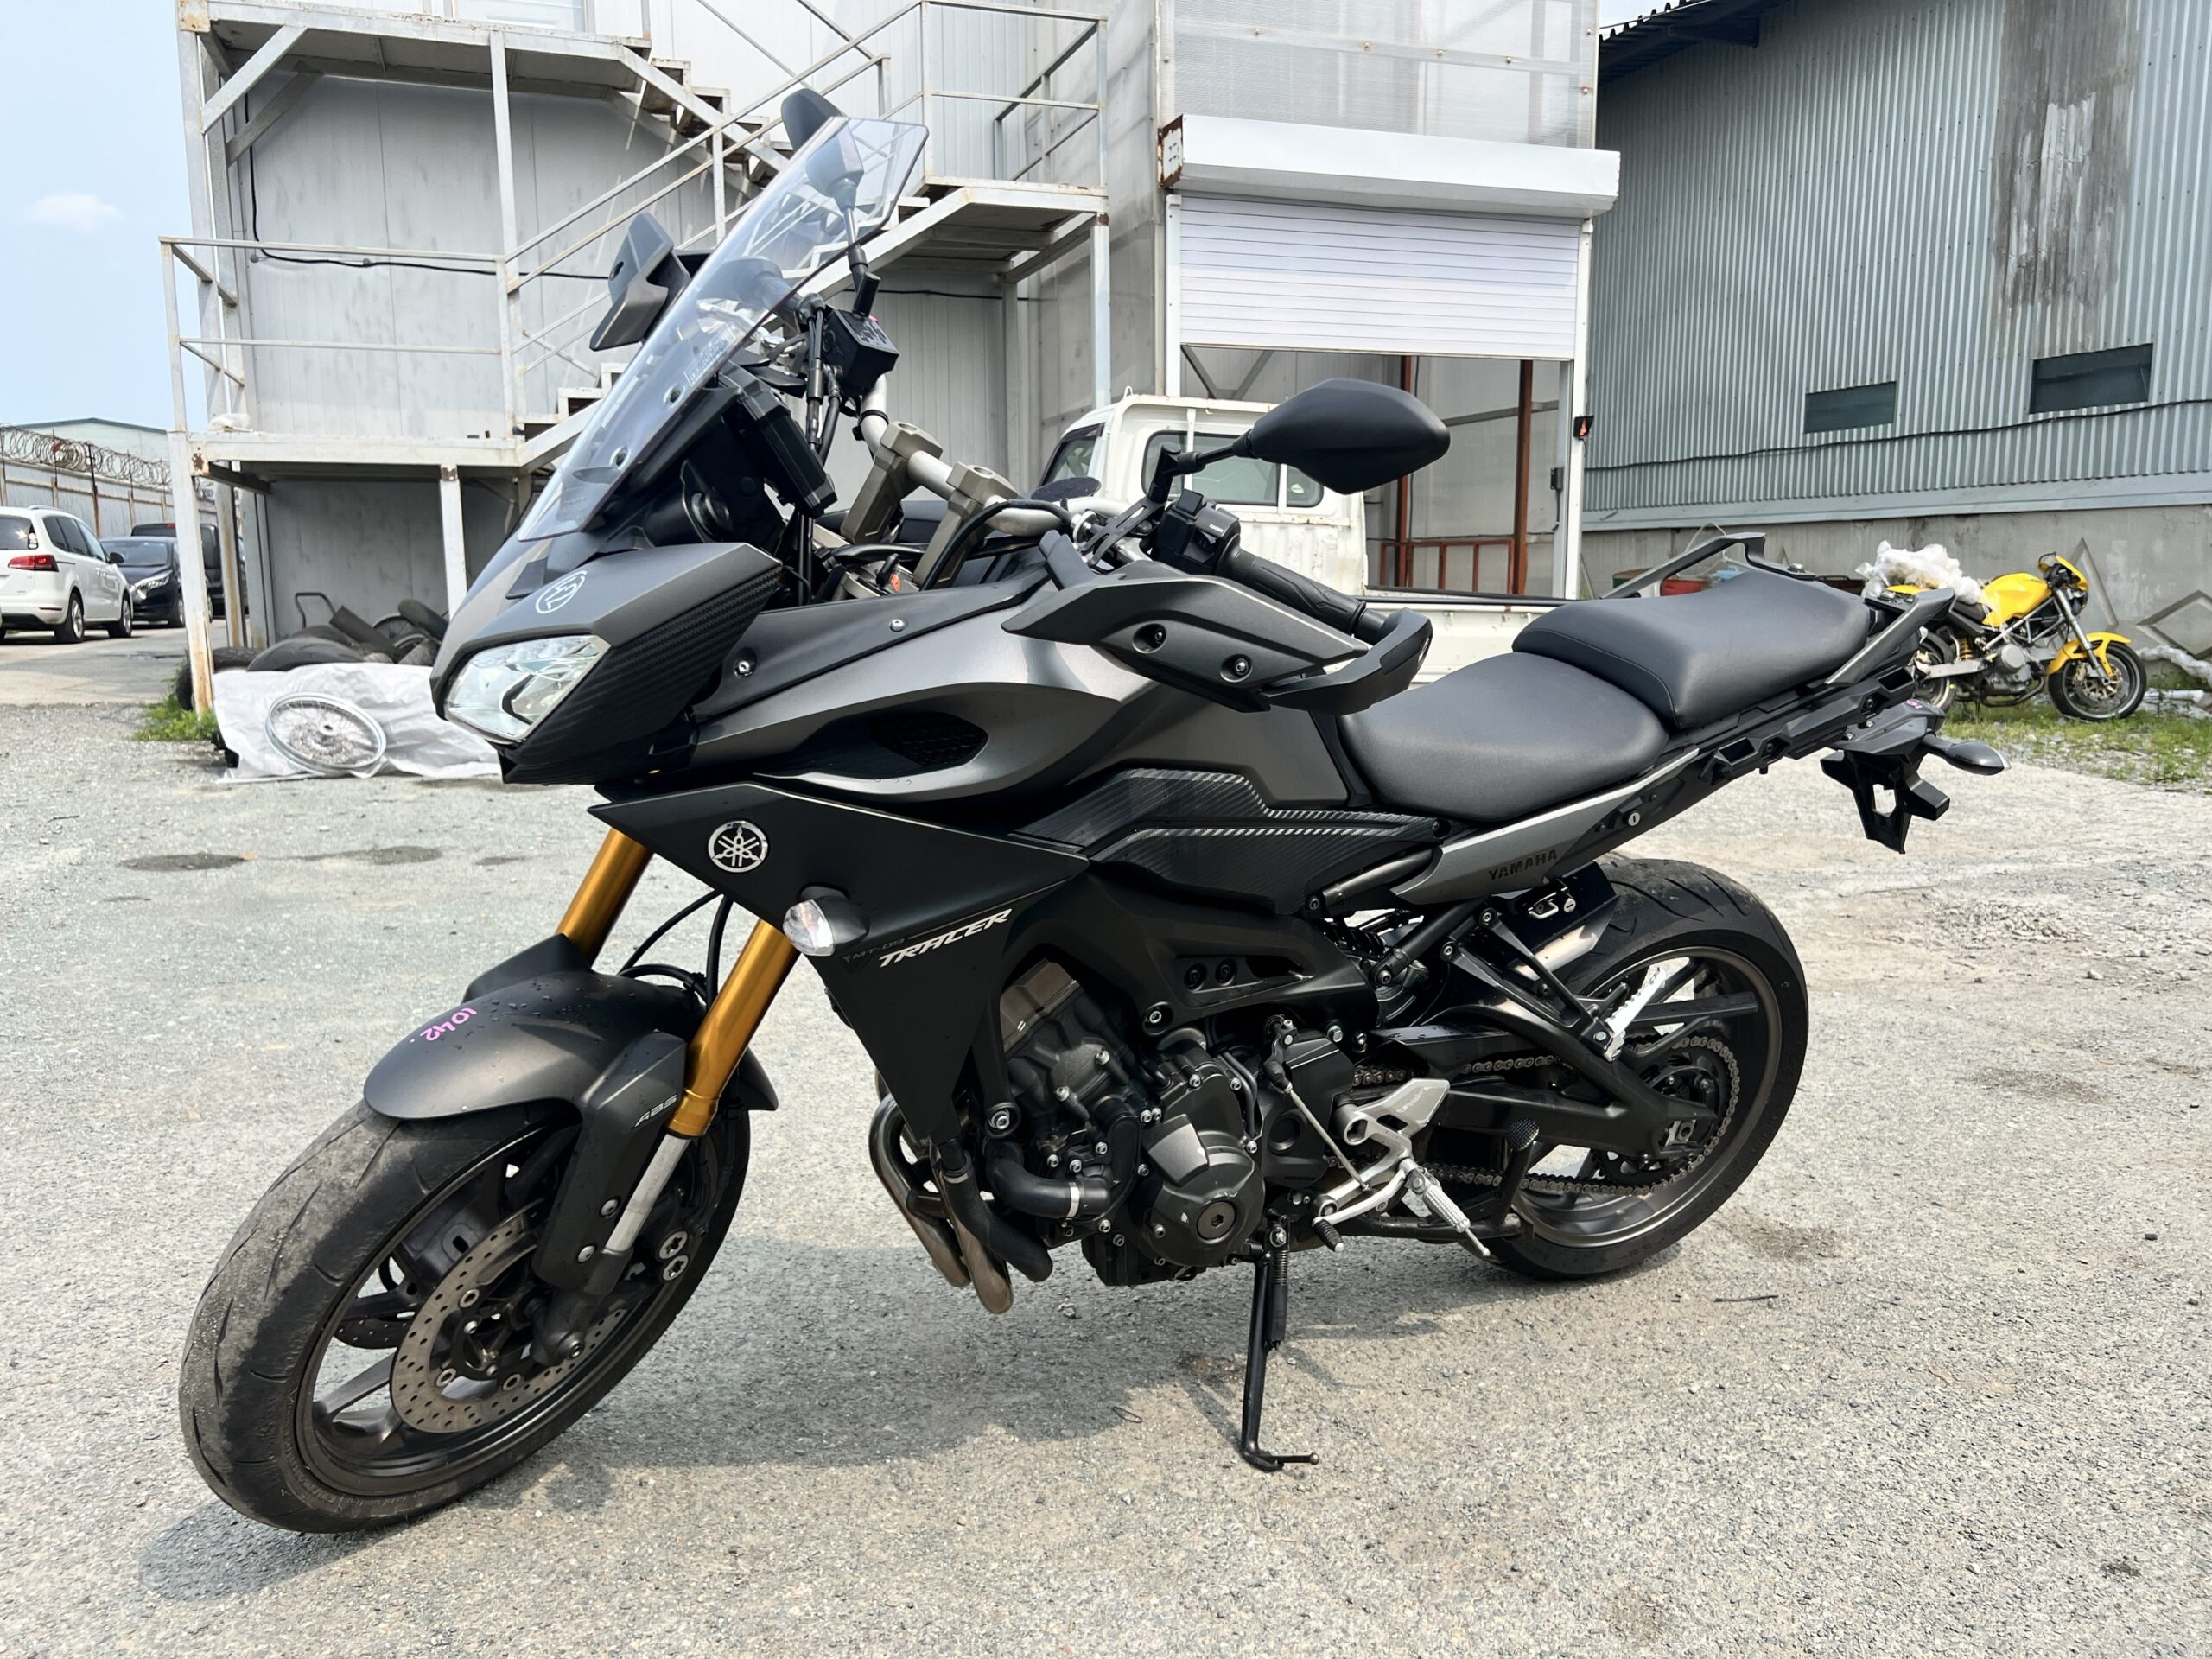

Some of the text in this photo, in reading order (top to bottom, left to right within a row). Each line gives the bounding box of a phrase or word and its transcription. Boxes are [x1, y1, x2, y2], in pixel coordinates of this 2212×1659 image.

[1488, 849, 1557, 880] YAMAHA
[879, 908, 1012, 968] TRACER
[634, 1094, 677, 1128] ABS
